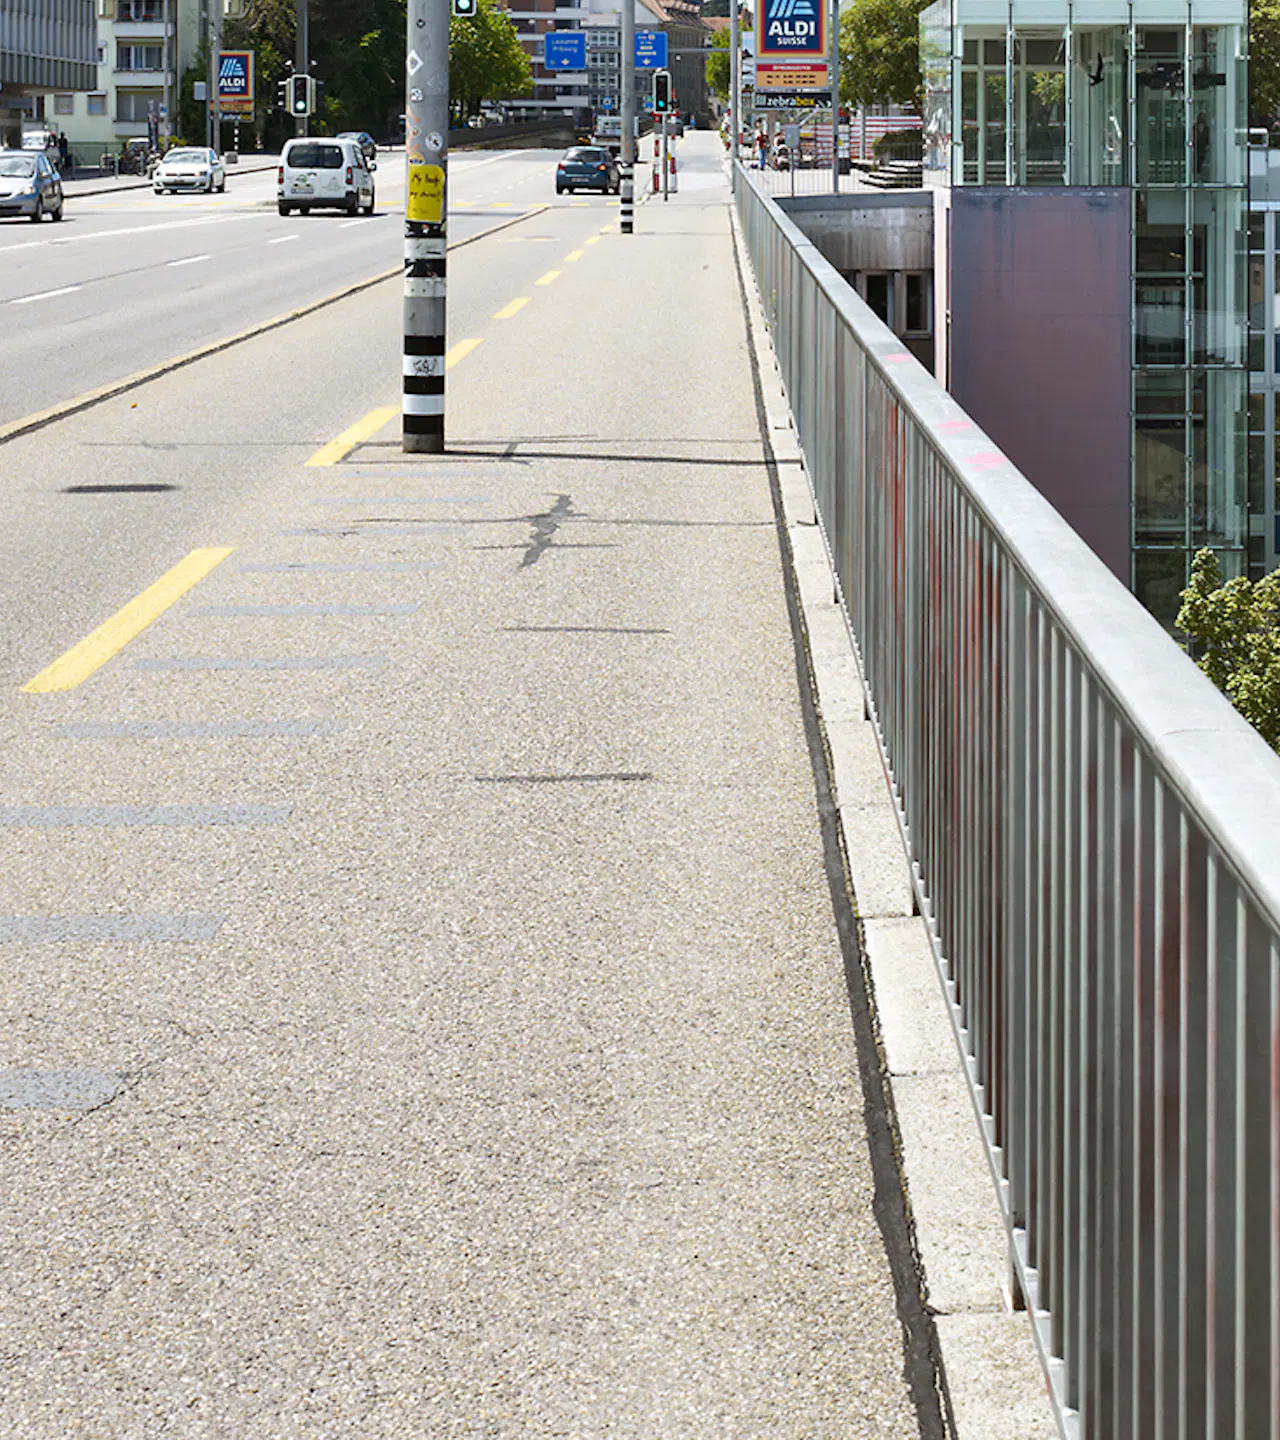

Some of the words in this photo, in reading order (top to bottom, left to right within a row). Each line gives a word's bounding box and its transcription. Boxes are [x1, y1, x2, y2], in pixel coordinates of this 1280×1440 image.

[768, 20, 816, 36] ALDI
[777, 37, 807, 46] SUISSE
[219, 77, 245, 87] ALDI
[766, 95, 816, 107] zebrabox
